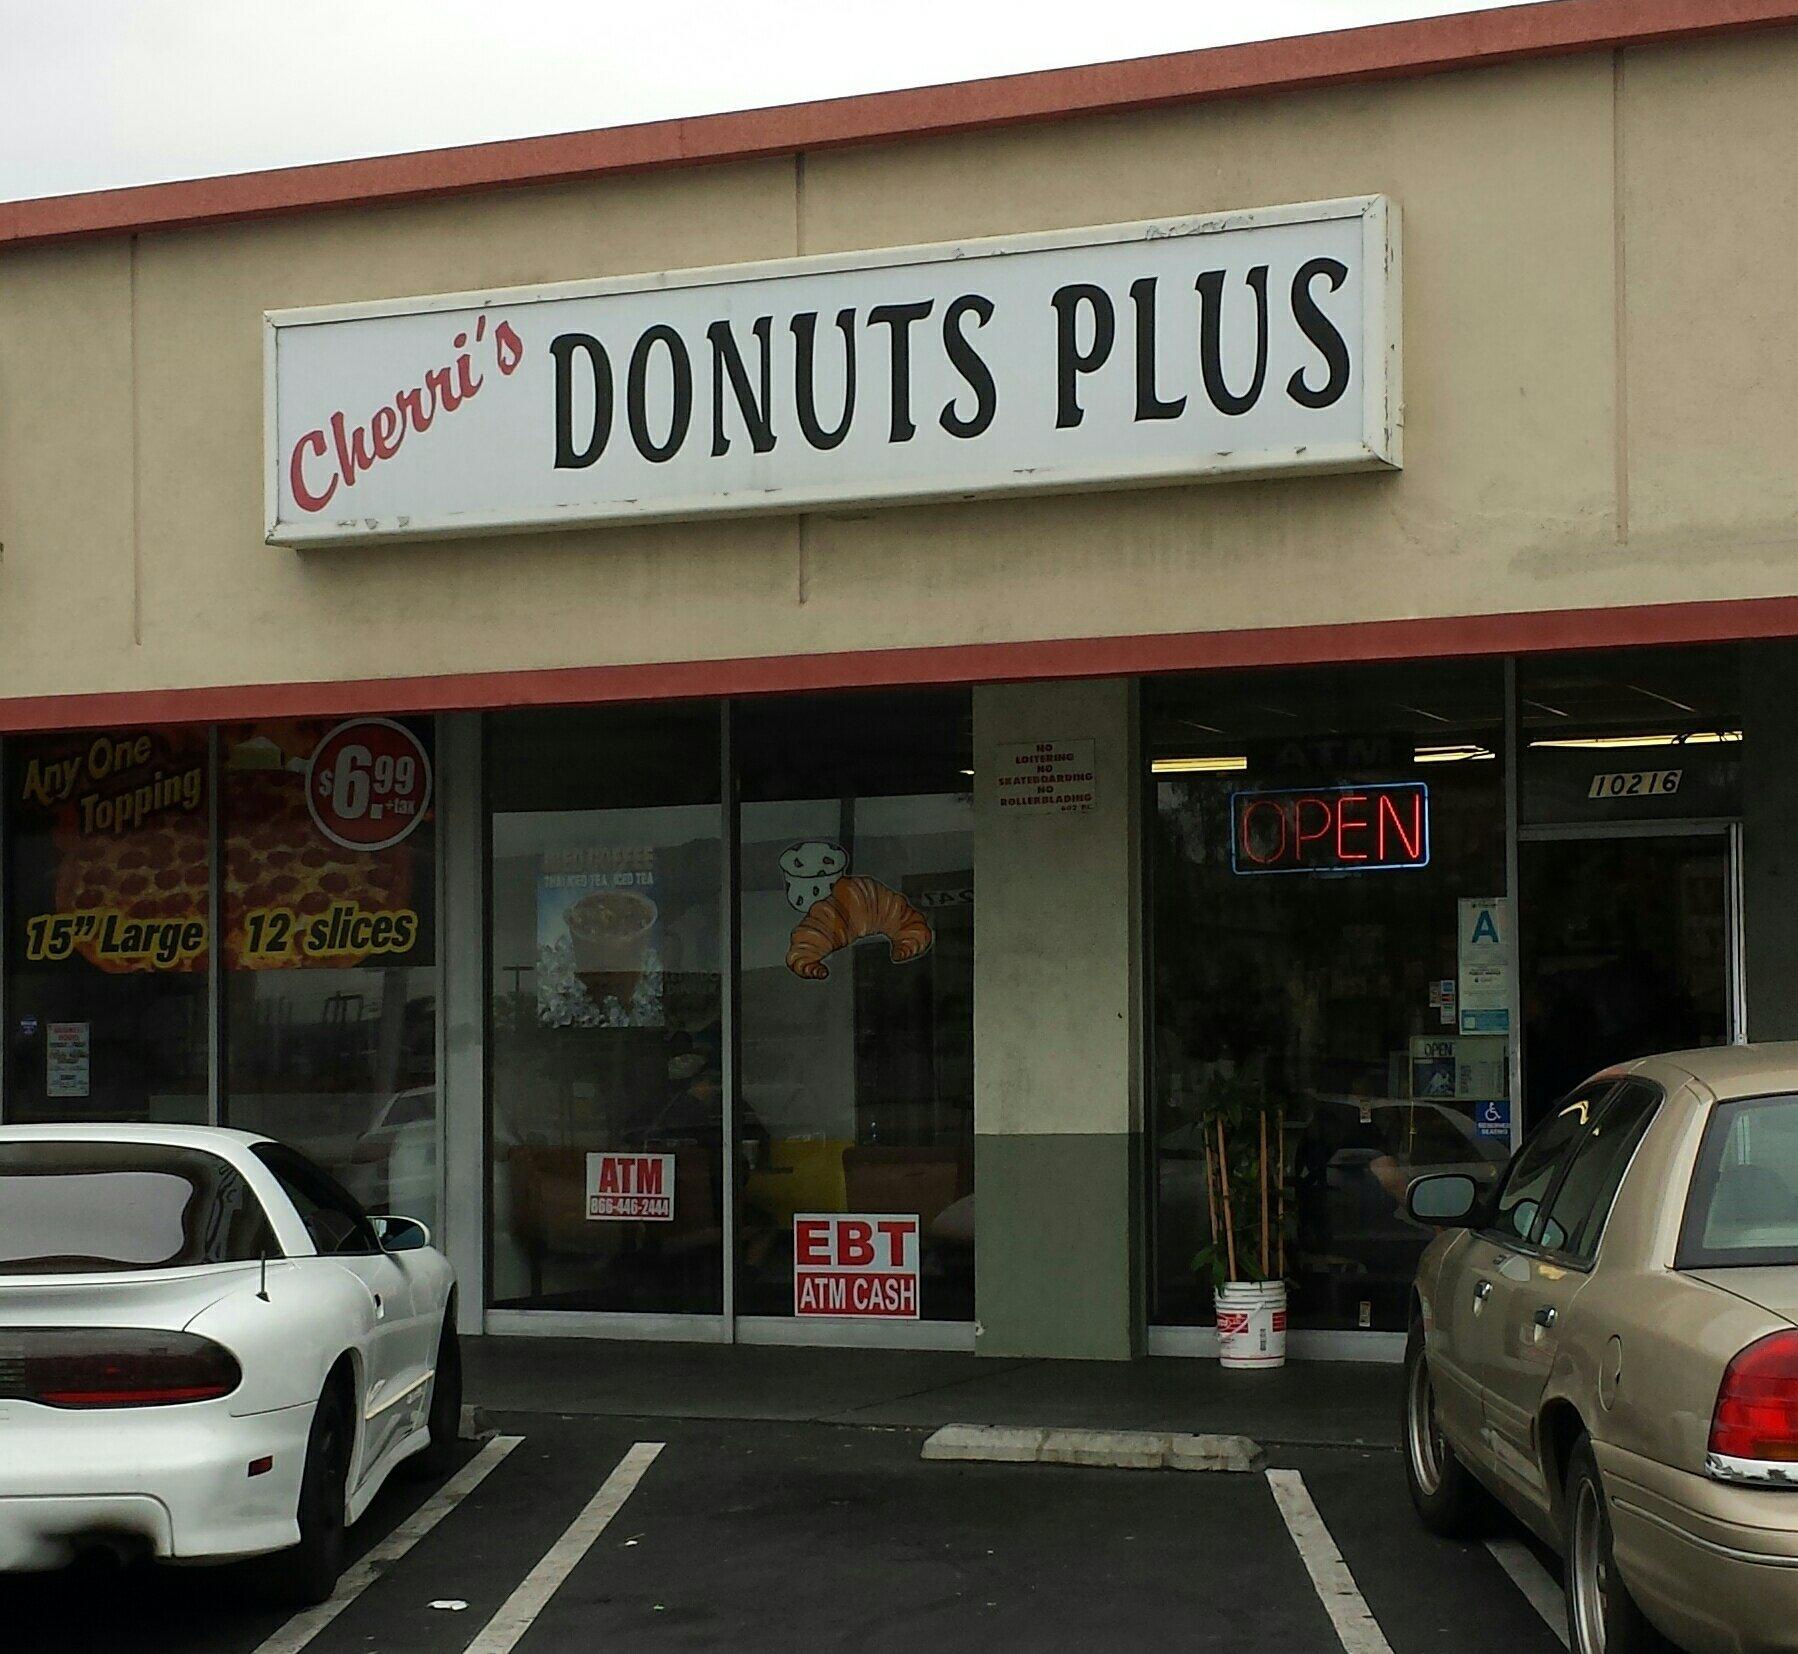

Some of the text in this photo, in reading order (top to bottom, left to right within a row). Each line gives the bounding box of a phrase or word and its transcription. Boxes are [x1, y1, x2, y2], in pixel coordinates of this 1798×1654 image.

[290, 256, 1351, 512] Cherri's DONUTS PLUS
[1016, 753, 1074, 764] LOITERING
[1036, 744, 1053, 752] NO
[22, 735, 152, 803] Any One
[998, 773, 1093, 786] SKATEBOARDING
[1037, 765, 1053, 773] NO
[1597, 770, 1678, 797] 10216
[81, 768, 201, 834] Topping
[1000, 794, 1092, 806] ROLLERBLADING
[1242, 793, 1421, 864] OPEN
[636, 870, 654, 885] TEA
[101, 913, 204, 964] Large
[248, 906, 413, 954] 12 slices
[1471, 910, 1499, 943] A
[600, 1158, 663, 1195] ATM
[590, 1198, 669, 1217] 866-446-2444
[796, 1220, 916, 1267] EBT
[800, 1277, 915, 1311] ATM CASH
